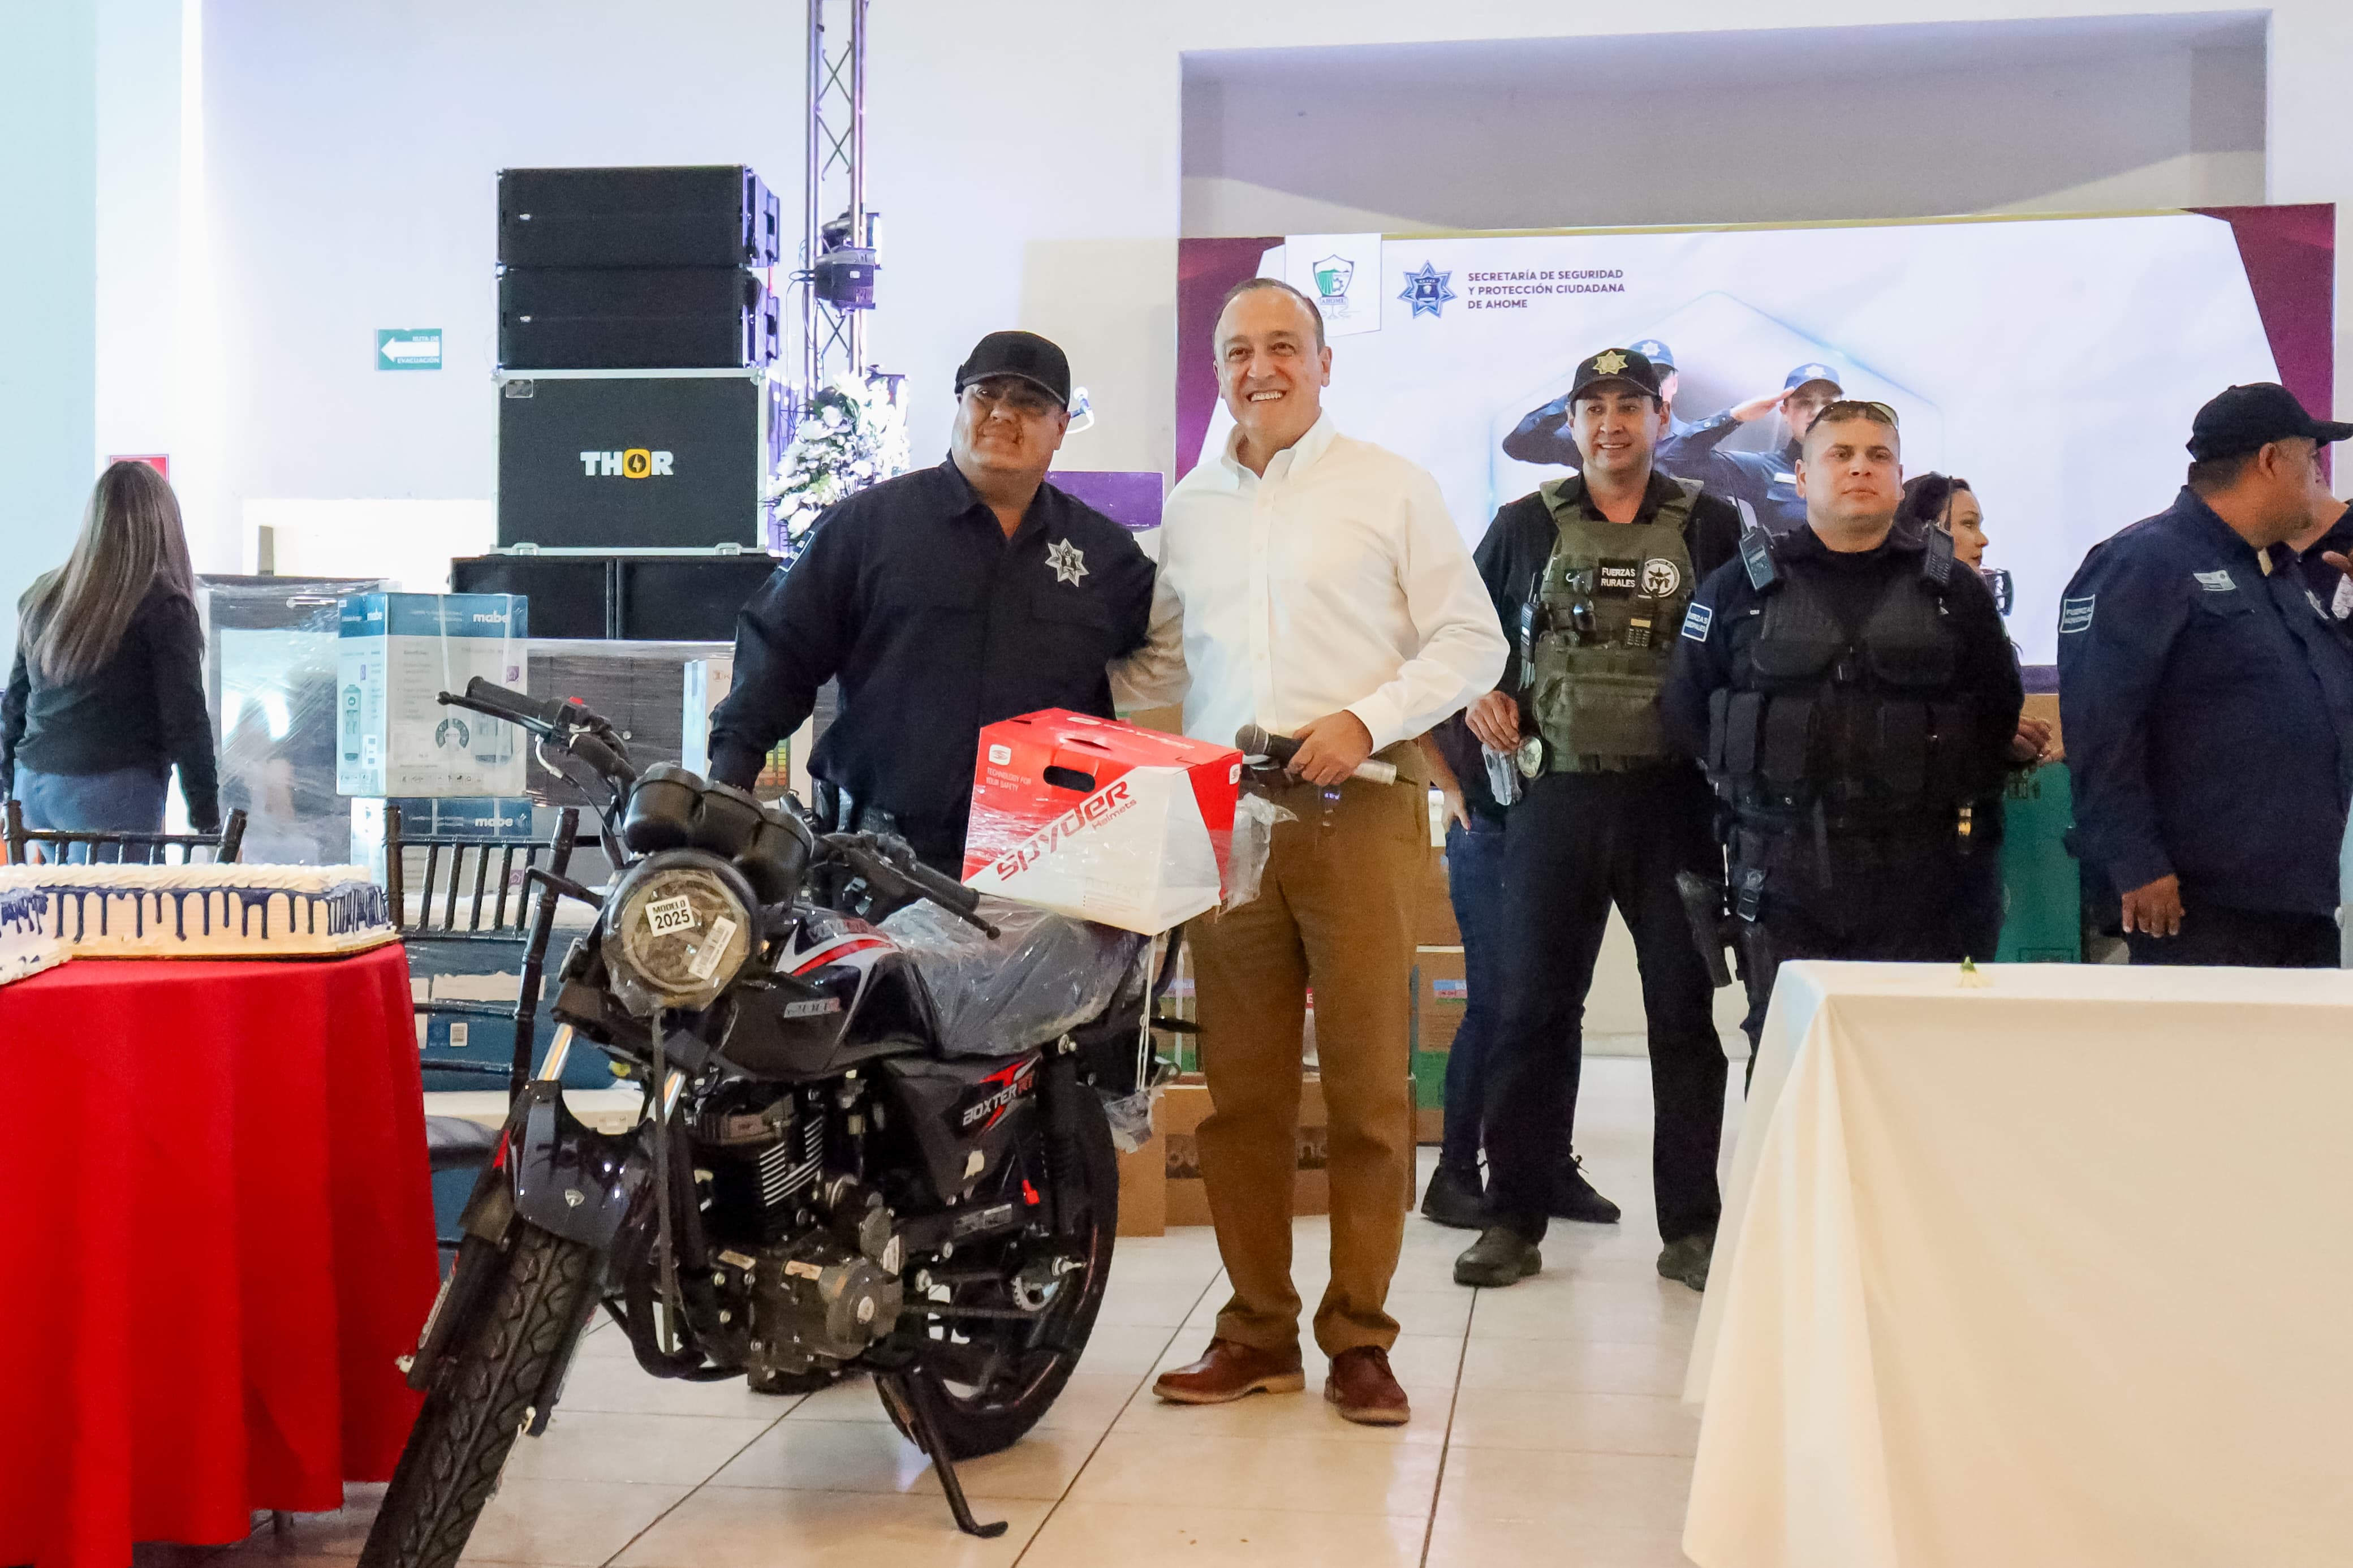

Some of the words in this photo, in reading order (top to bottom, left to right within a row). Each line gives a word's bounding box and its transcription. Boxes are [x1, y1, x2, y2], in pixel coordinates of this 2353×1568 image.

[1468, 270, 1537, 281] SECRETARÍA
[1540, 271, 1555, 280] DE
[1558, 269, 1623, 279] SEGURIDAD
[1468, 286, 1475, 295] Y
[1478, 283, 1553, 295] PROTECCIÓN
[1556, 284, 1625, 294] CIUDADANA
[1468, 300, 1482, 309] DE
[1486, 299, 1528, 309] AHOME
[580, 449, 674, 479] THOR
[1602, 567, 1636, 577] FUERZAS
[1601, 578, 1636, 588] RURALES
[652, 899, 686, 915] MODELO
[654, 909, 690, 929] 2025
